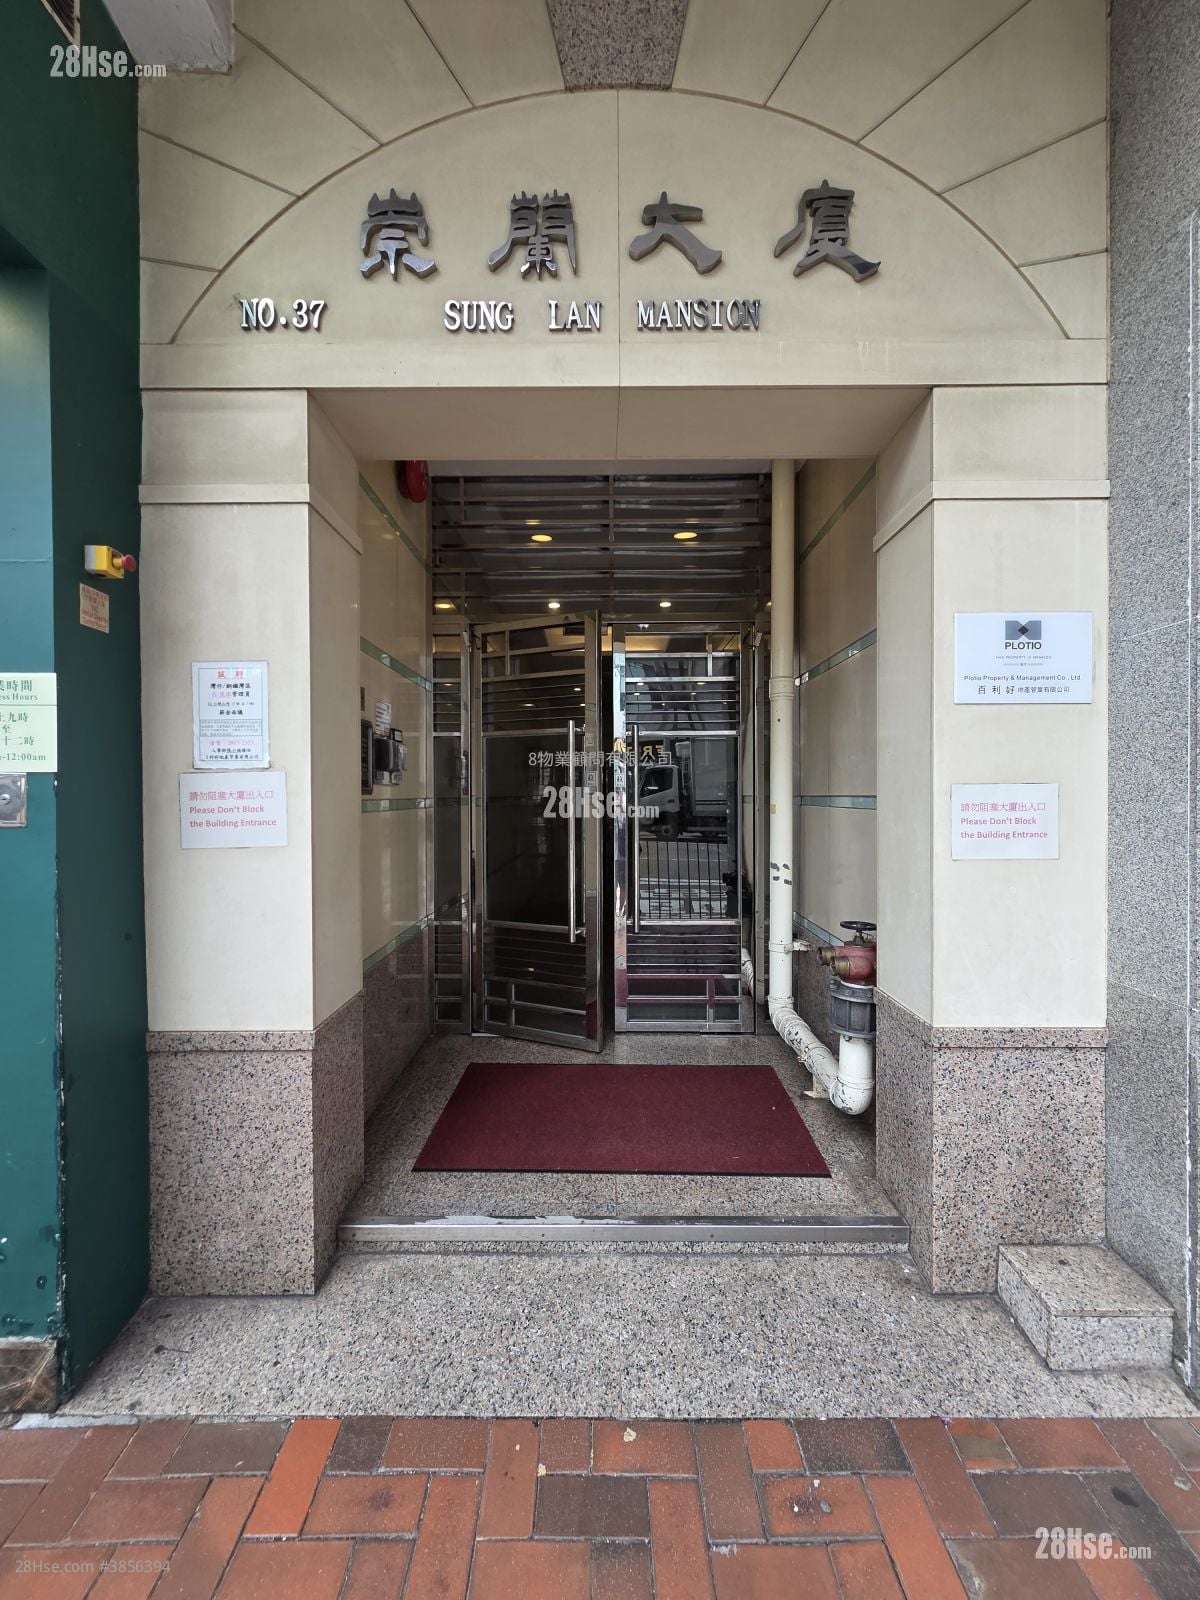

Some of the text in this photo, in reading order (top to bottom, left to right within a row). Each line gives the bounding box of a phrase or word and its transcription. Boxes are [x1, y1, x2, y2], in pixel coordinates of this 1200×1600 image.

[360, 178, 881, 282] 崇蘭大廈
[240, 298, 328, 332] NO.37
[443, 300, 514, 332] SUNG
[549, 300, 603, 331] LAN
[1005, 641, 1042, 650] PLOTIO
[978, 685, 1015, 695] 百利好
[189, 791, 273, 801] 請勿阻塞大廈出入口
[960, 803, 1046, 812] 請勿阻塞大廈出入口
[206, 820, 238, 828] Building
[240, 819, 276, 827] Entrance
[977, 831, 1010, 839] Building
